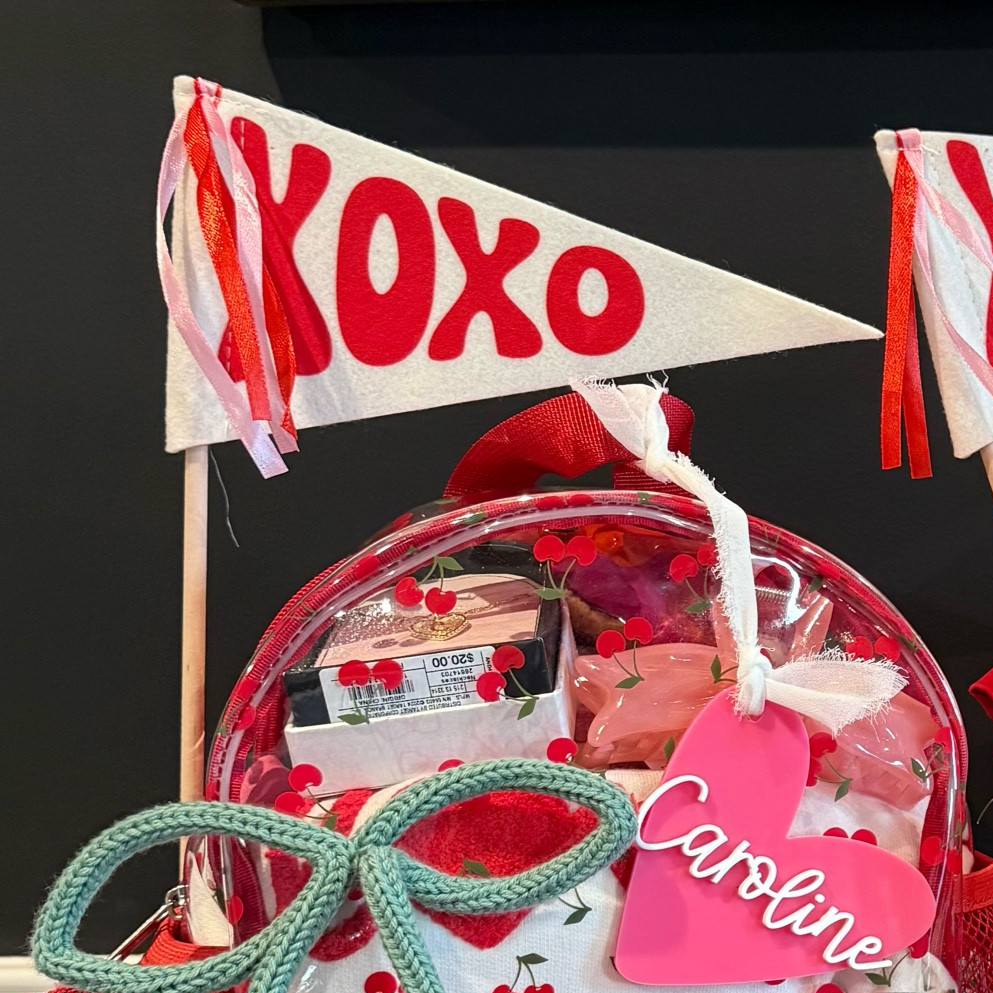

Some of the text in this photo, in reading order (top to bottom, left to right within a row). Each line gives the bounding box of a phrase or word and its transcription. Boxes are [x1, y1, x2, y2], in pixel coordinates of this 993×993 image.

[219, 116, 645, 381] XOXO
[432, 652, 475, 668] $20.00
[636, 775, 893, 972] Caroline
